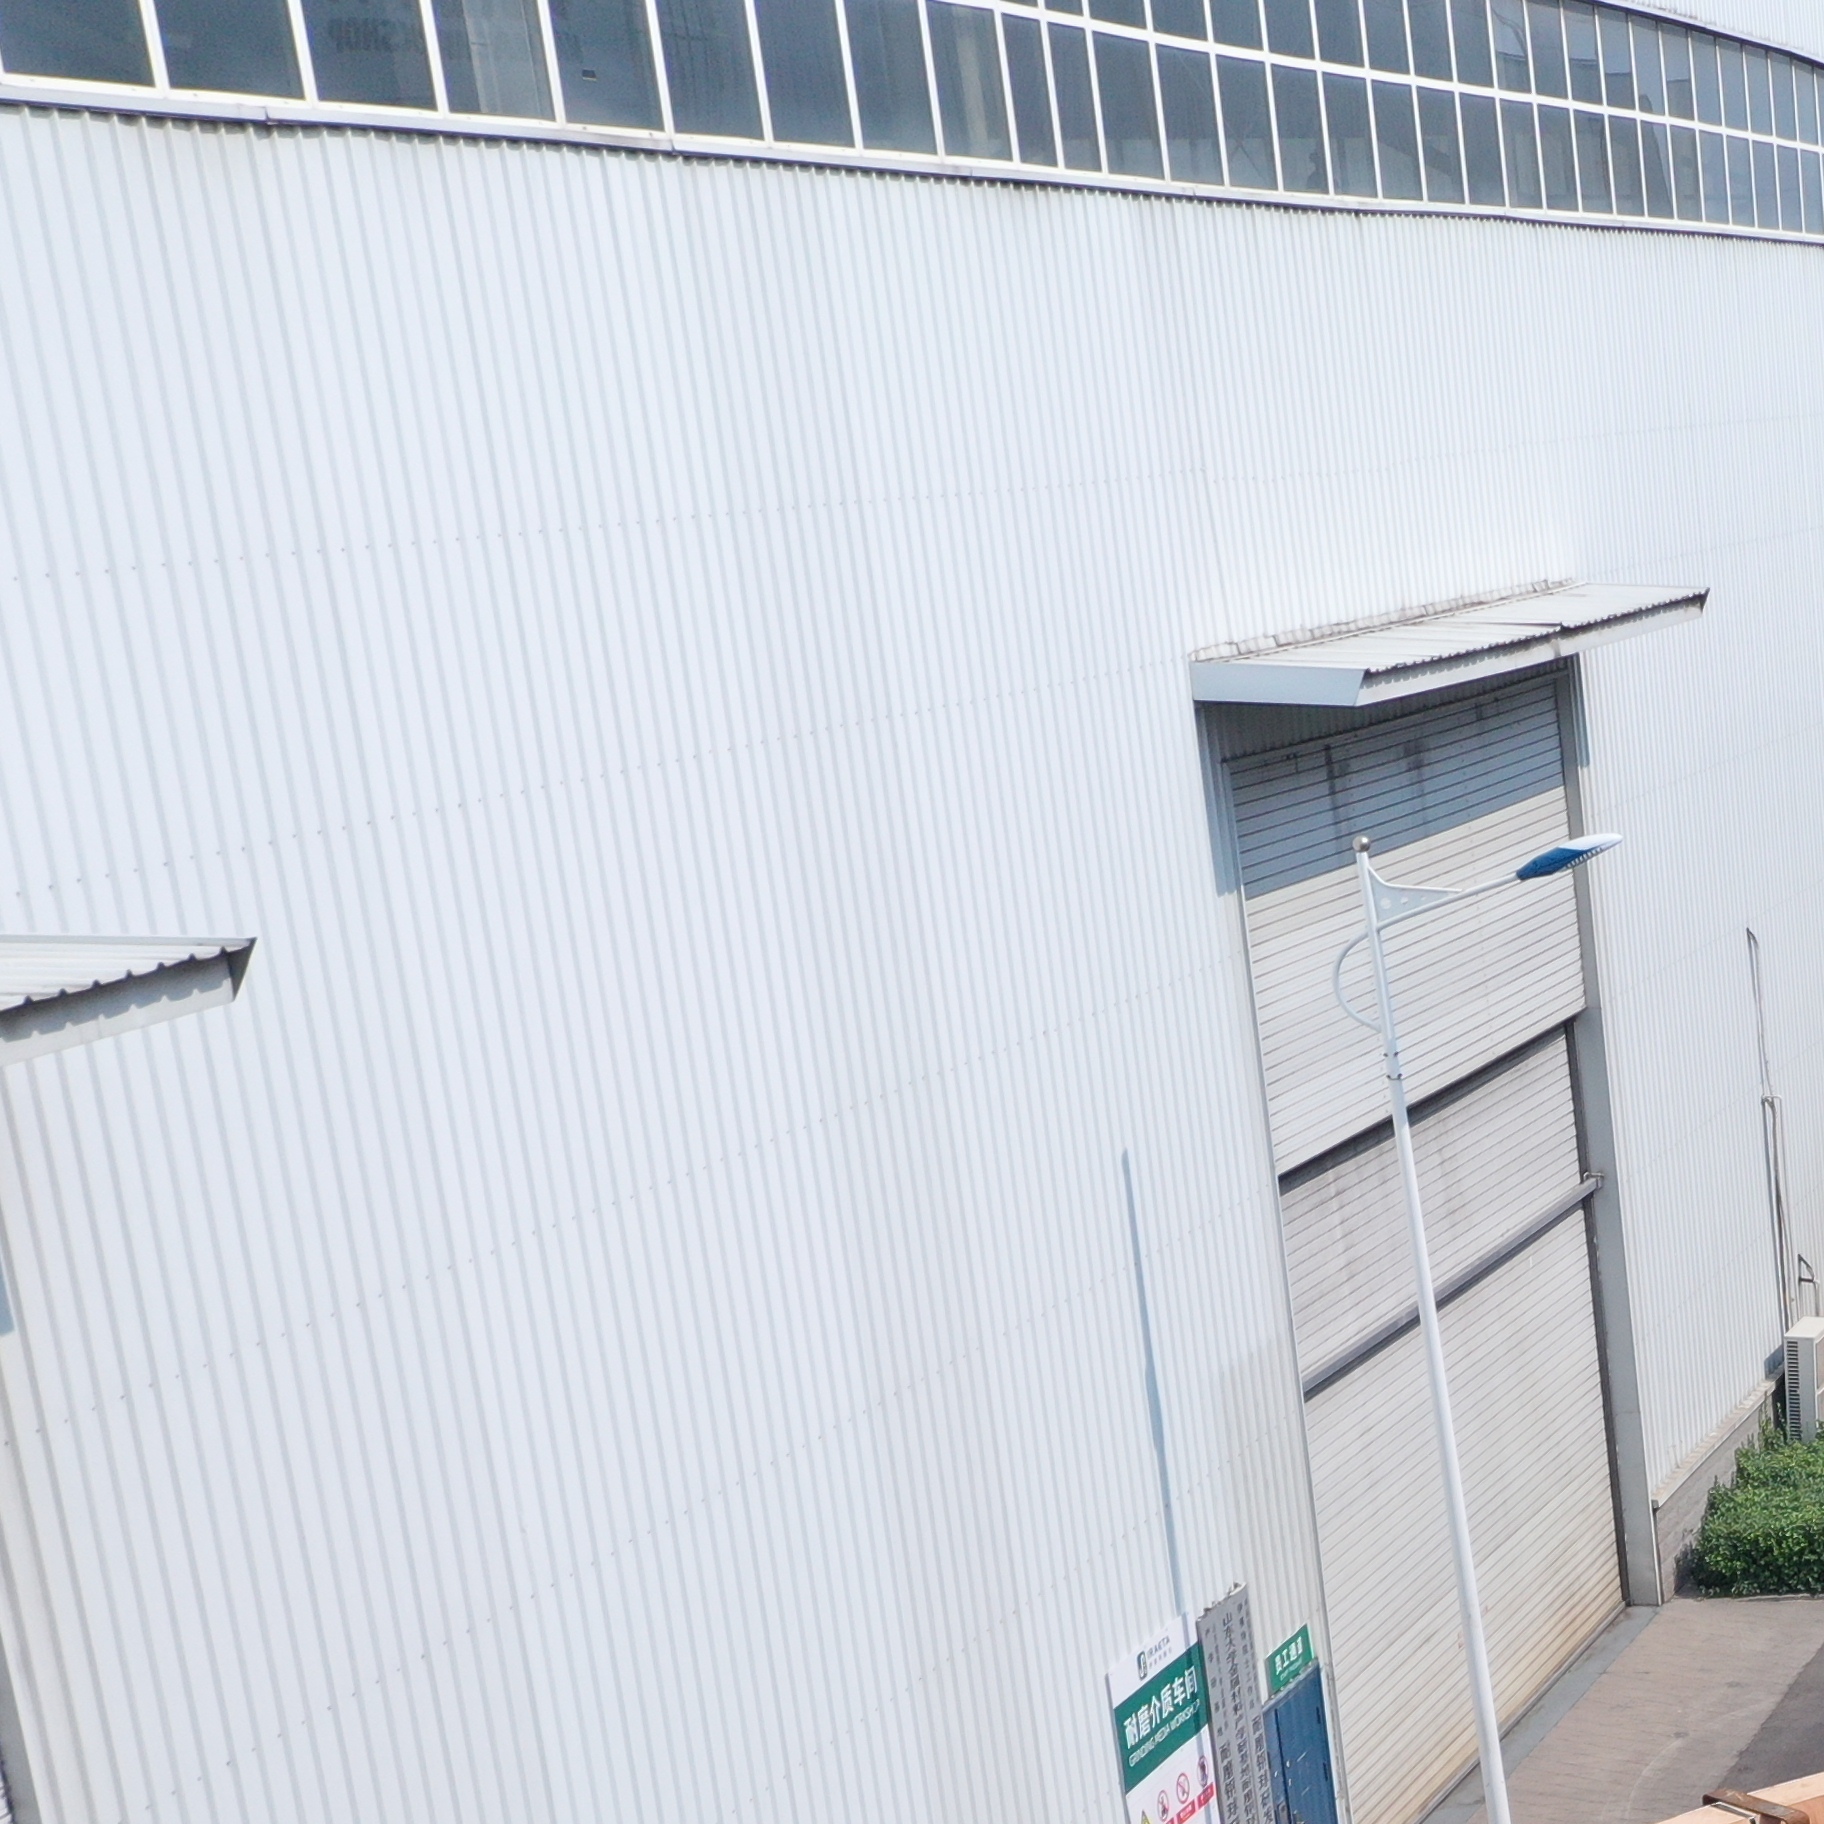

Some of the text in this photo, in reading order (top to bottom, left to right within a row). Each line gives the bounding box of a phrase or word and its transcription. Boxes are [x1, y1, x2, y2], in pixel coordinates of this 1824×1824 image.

[1123, 1665, 1198, 1750] 耐磨介质车间
